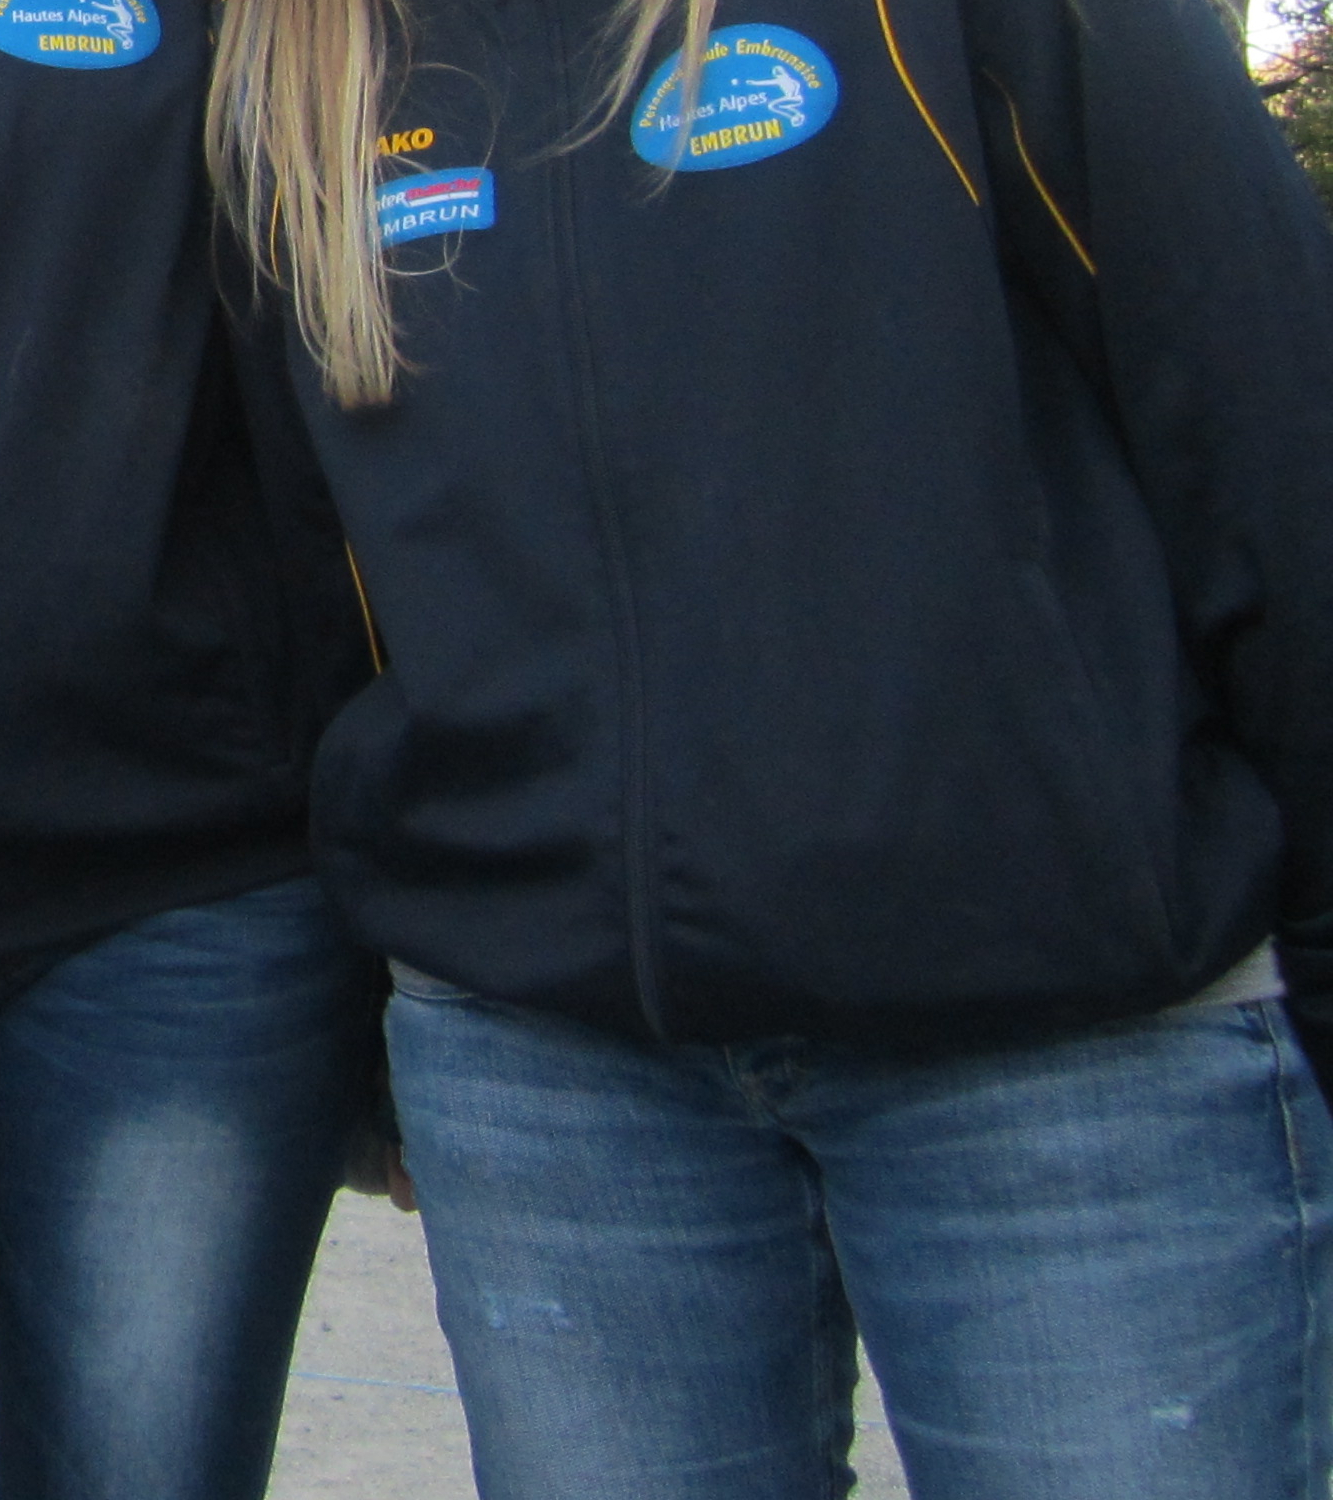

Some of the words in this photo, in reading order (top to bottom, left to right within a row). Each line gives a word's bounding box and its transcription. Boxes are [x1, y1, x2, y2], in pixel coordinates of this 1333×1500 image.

[12, 9, 63, 23] Hautes
[67, 8, 107, 25] Alpes
[39, 34, 116, 54] EMBRUN
[736, 38, 822, 89] Embrunaise
[719, 91, 768, 113] Alpes
[376, 127, 434, 156] AKO
[690, 118, 782, 156] EMBRUN
[384, 204, 479, 236] MBRUN
